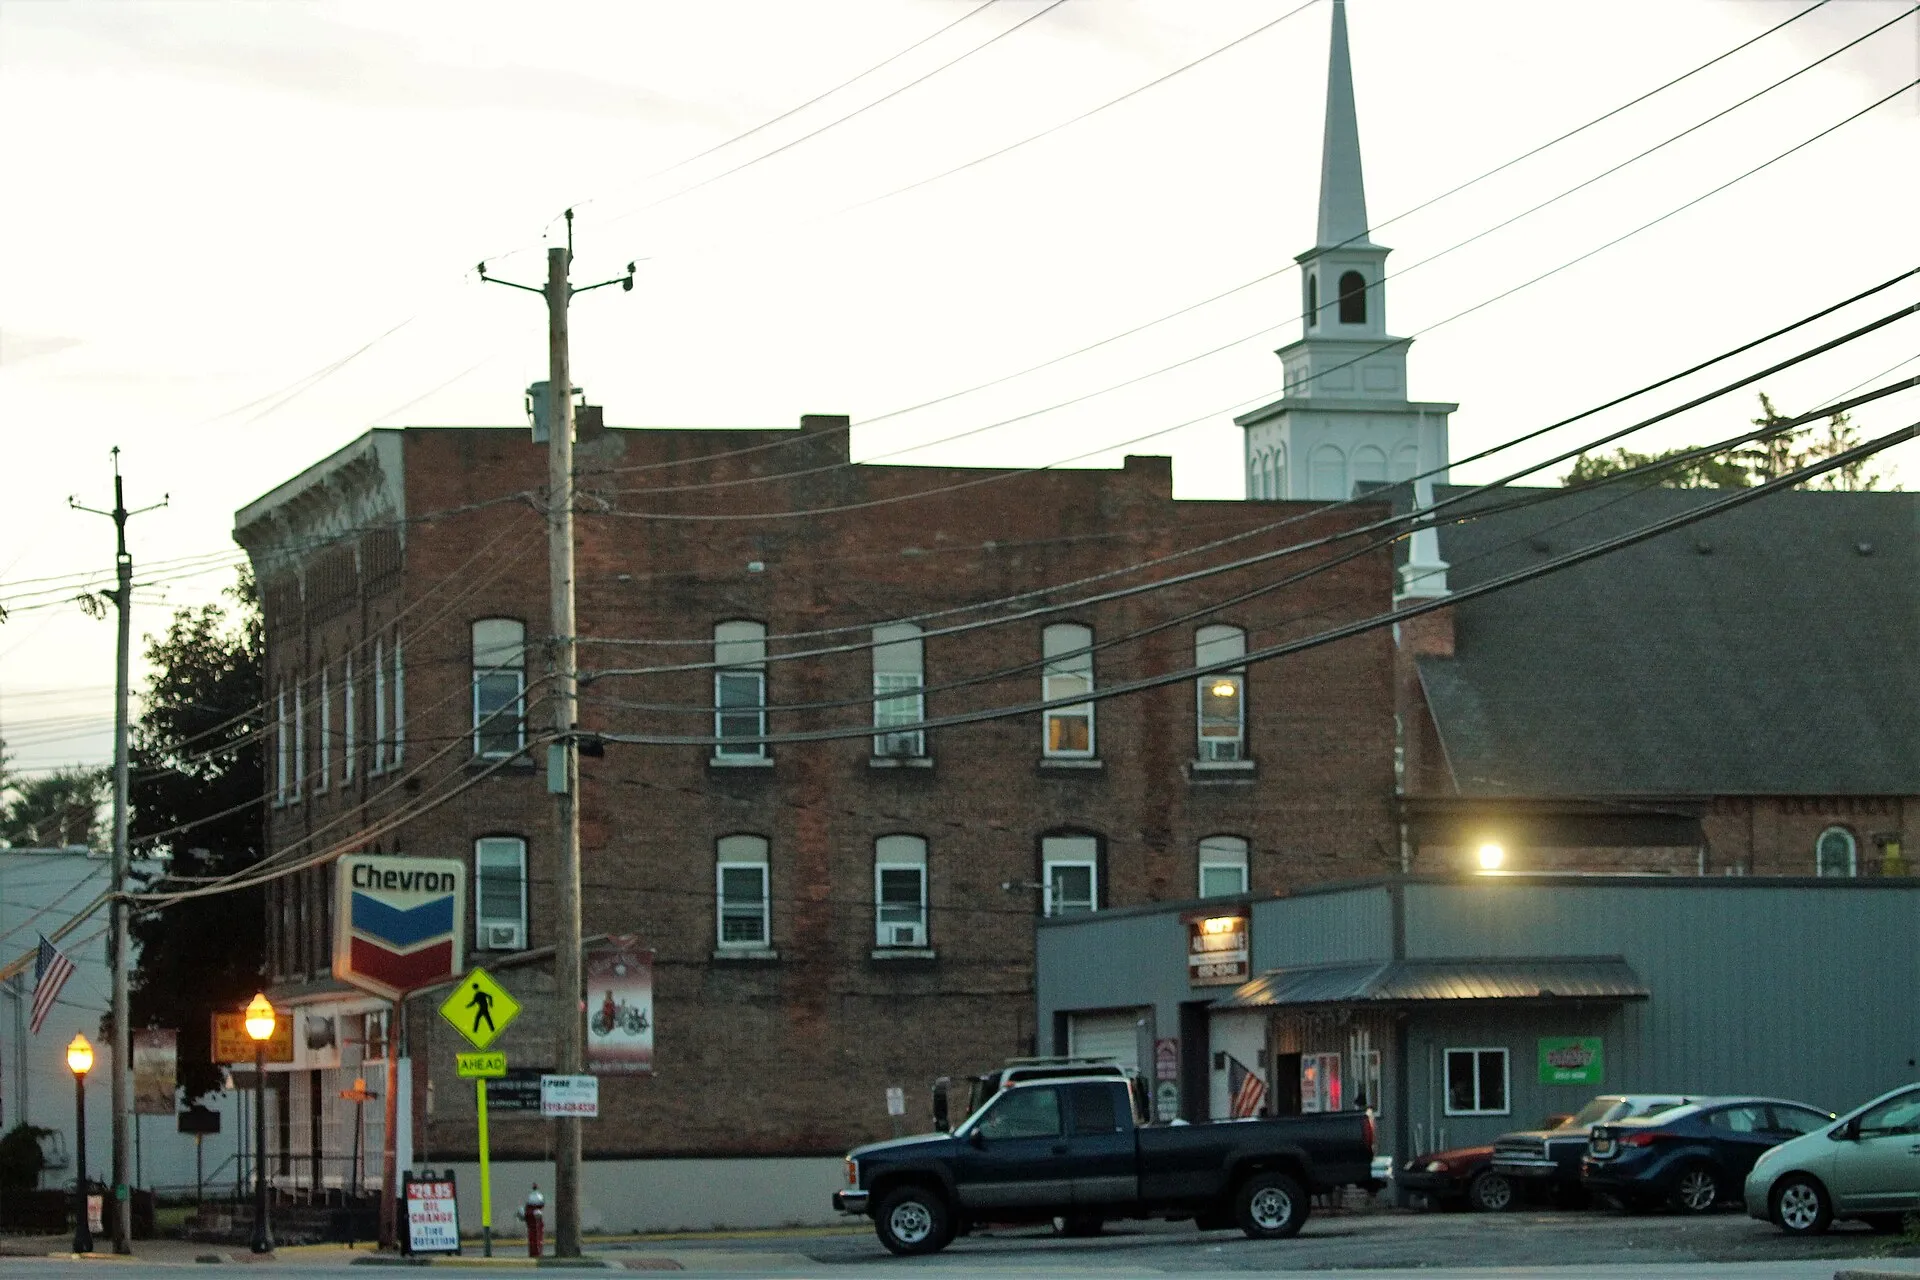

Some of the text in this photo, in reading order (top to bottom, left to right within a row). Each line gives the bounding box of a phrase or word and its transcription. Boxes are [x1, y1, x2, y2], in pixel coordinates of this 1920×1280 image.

[352, 864, 455, 892] Chevron
[461, 1059, 501, 1070] AHEAD
[423, 1201, 439, 1211] OIL
[411, 1212, 453, 1223] CHANGE
[424, 1226, 444, 1236] TIRE
[412, 1237, 456, 1246] ROTATION
